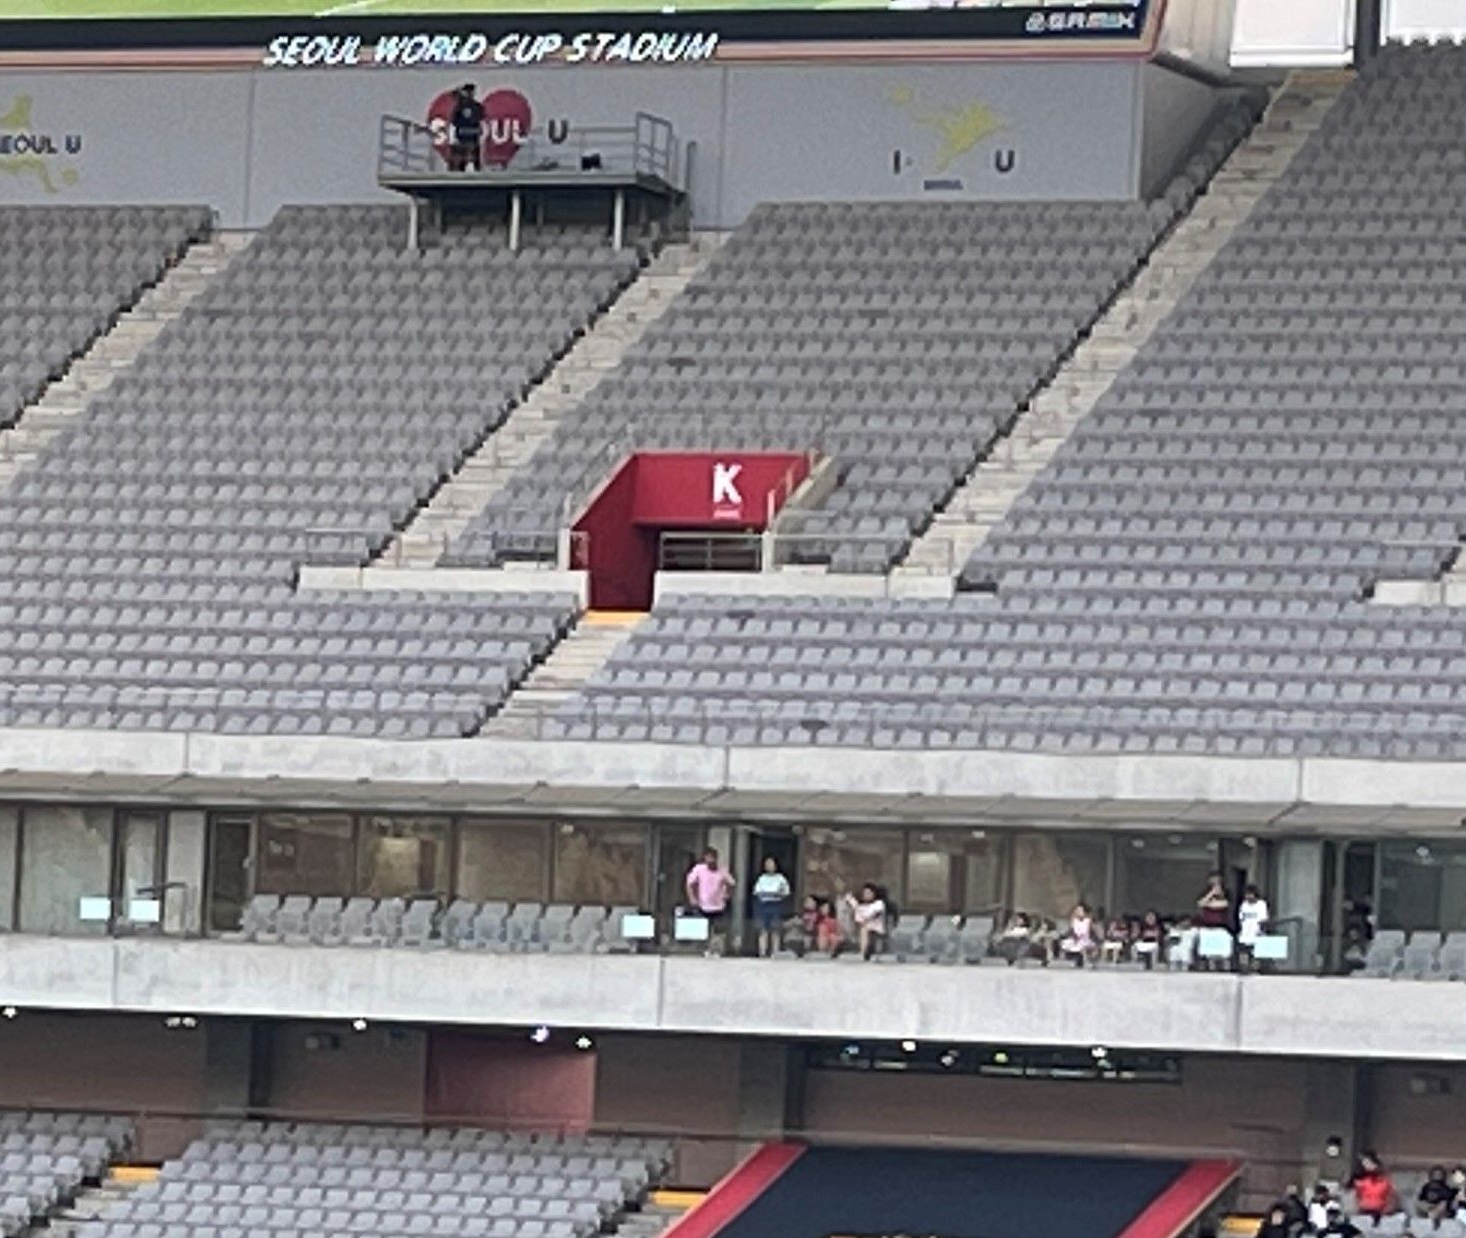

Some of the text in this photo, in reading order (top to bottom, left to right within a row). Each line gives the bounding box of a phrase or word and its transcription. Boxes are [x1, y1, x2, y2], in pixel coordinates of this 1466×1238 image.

[264, 33, 720, 64] SEOUL WORLD CUP STADIUM
[548, 120, 569, 144] U
[995, 150, 1015, 173] U
[713, 463, 741, 503] K
